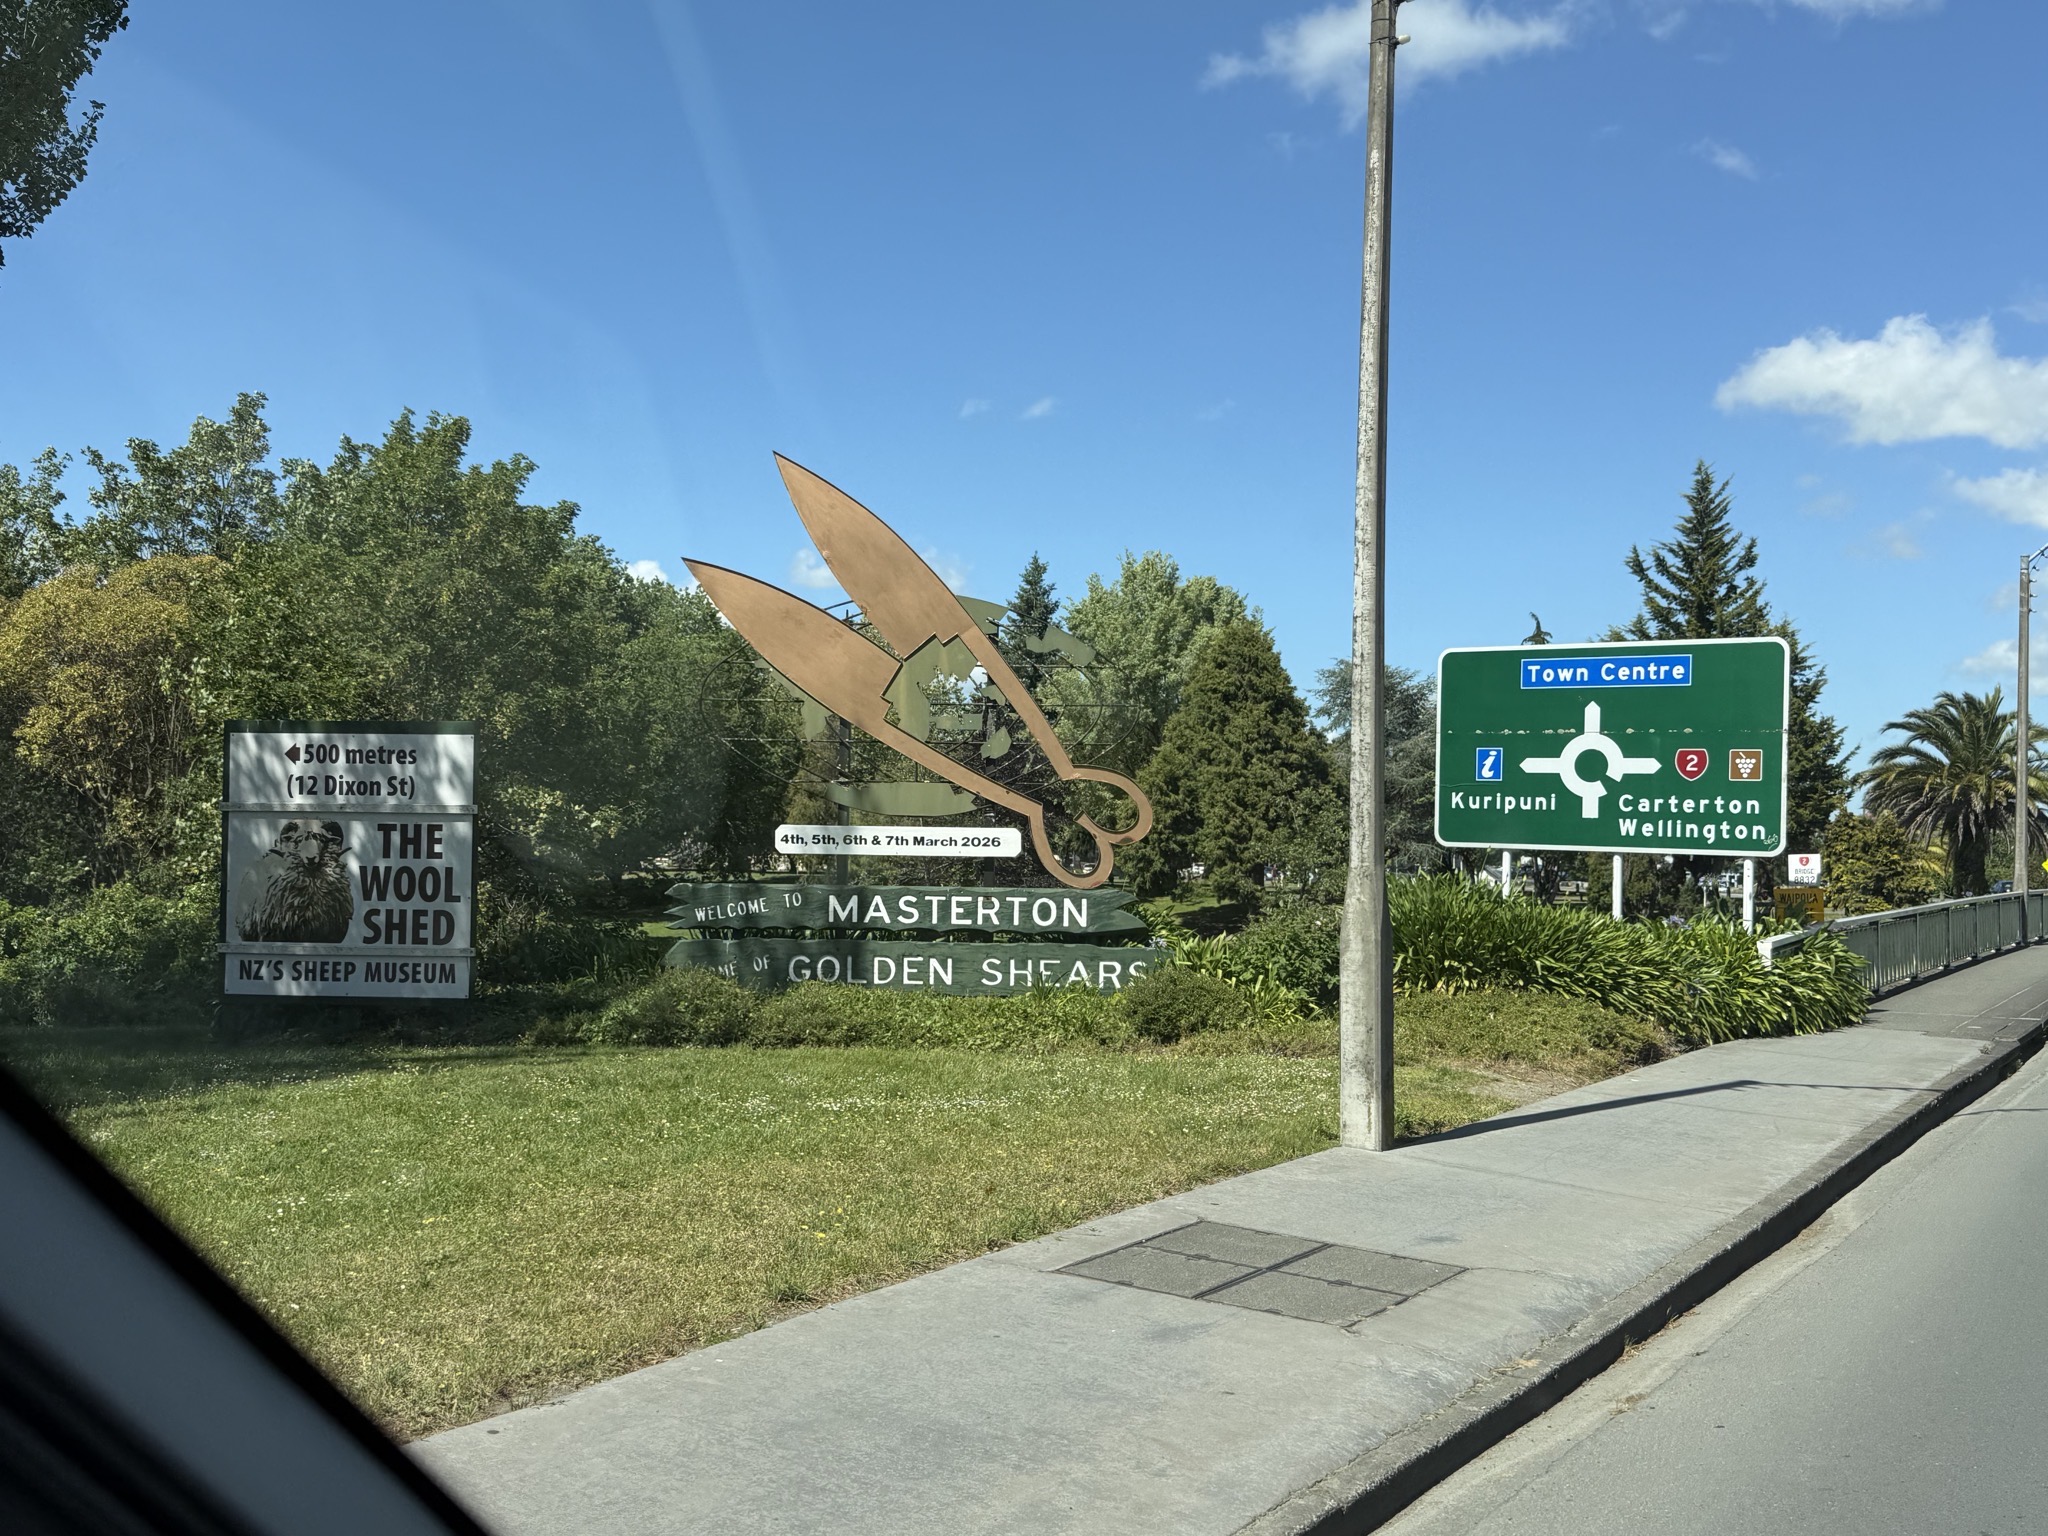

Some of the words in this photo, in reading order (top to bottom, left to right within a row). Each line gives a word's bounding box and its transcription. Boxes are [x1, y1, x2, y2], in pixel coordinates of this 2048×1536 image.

[1527, 664, 1589, 683] Town
[1600, 662, 1685, 682] Centre
[304, 744, 340, 765] 500
[345, 745, 417, 765] metres
[1685, 754, 1699, 772] 2
[287, 774, 318, 799] (12
[324, 775, 382, 797] Dixon
[386, 775, 416, 800] St)
[1451, 791, 1557, 814] Kuripuni
[1618, 794, 1760, 815] Carterton
[377, 823, 443, 860] THE
[780, 834, 808, 846] 4th,
[811, 834, 840, 846] 5th,
[843, 834, 868, 846] 6th
[871, 835, 882, 846] &
[885, 835, 909, 847] 7th
[913, 835, 958, 847] March
[961, 836, 1001, 848] 2026
[1618, 818, 1766, 844] Wellington
[359, 865, 462, 903] WOOL
[694, 897, 770, 922] WELCOME
[783, 892, 802, 909] TO
[828, 895, 1088, 928] MASTERTON
[362, 908, 456, 945] SHED
[239, 959, 284, 981] NZ'S
[291, 960, 357, 983] SHEEP
[364, 962, 456, 984] MUSEUM
[753, 954, 770, 972] OF
[788, 955, 953, 986] GOLDEN
